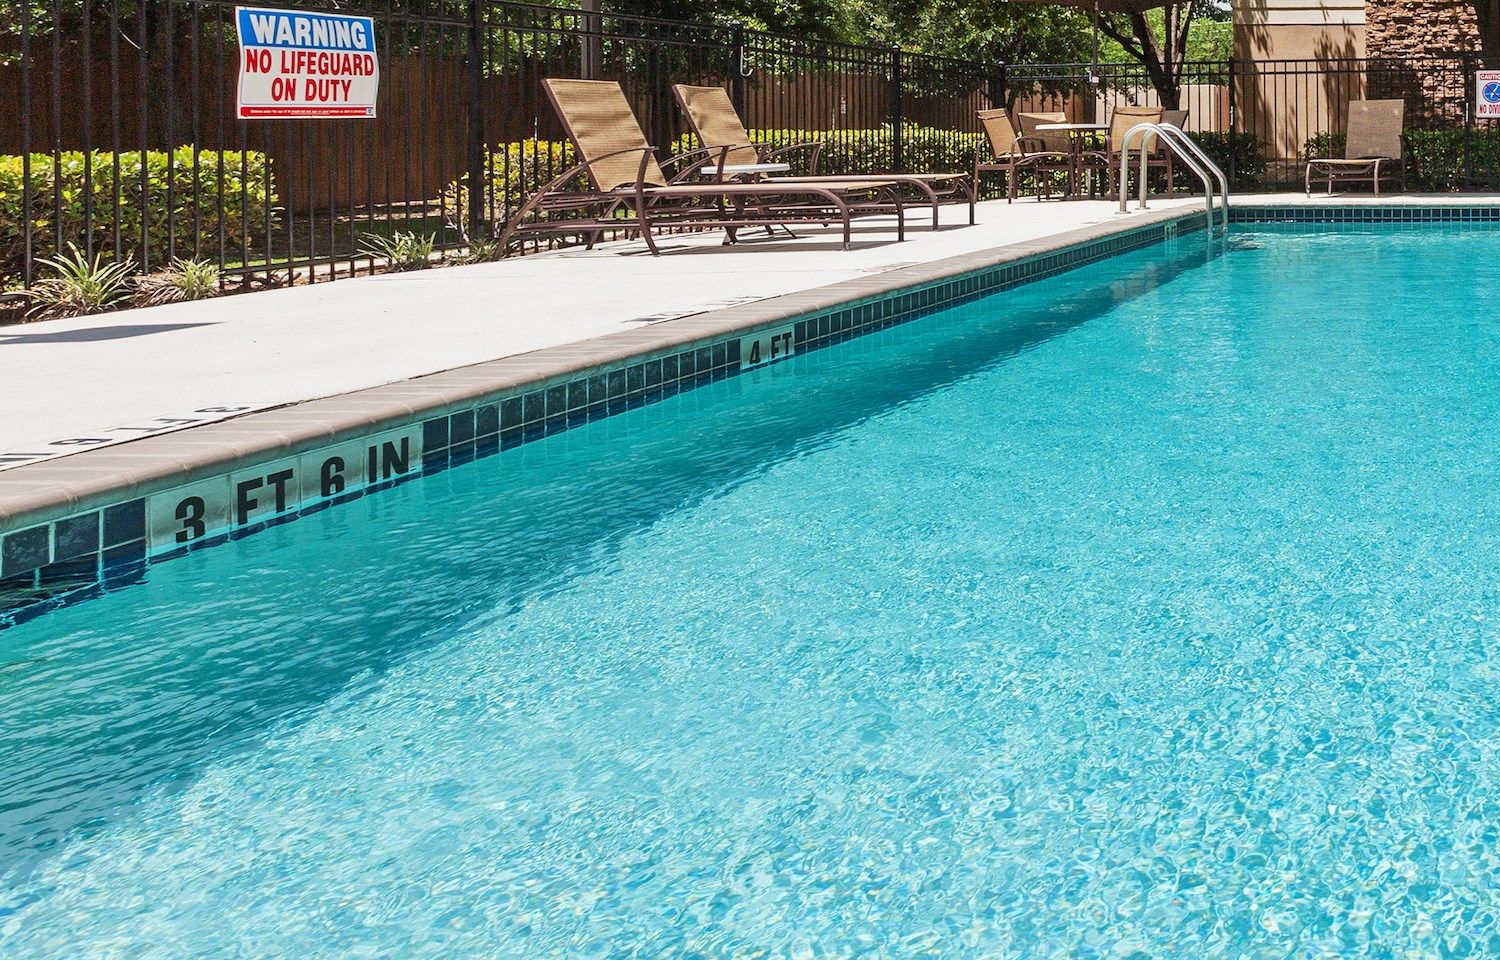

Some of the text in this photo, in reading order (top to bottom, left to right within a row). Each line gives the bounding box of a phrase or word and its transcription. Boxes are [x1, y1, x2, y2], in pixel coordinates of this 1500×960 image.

[250, 14, 368, 49] WARNING
[246, 49, 375, 76] NO LIFEGUARD
[271, 77, 352, 103] ON DUTY
[1480, 105, 1487, 114] NO
[749, 332, 792, 364] 4 FT
[175, 437, 410, 543] 3 FT 6 IN
